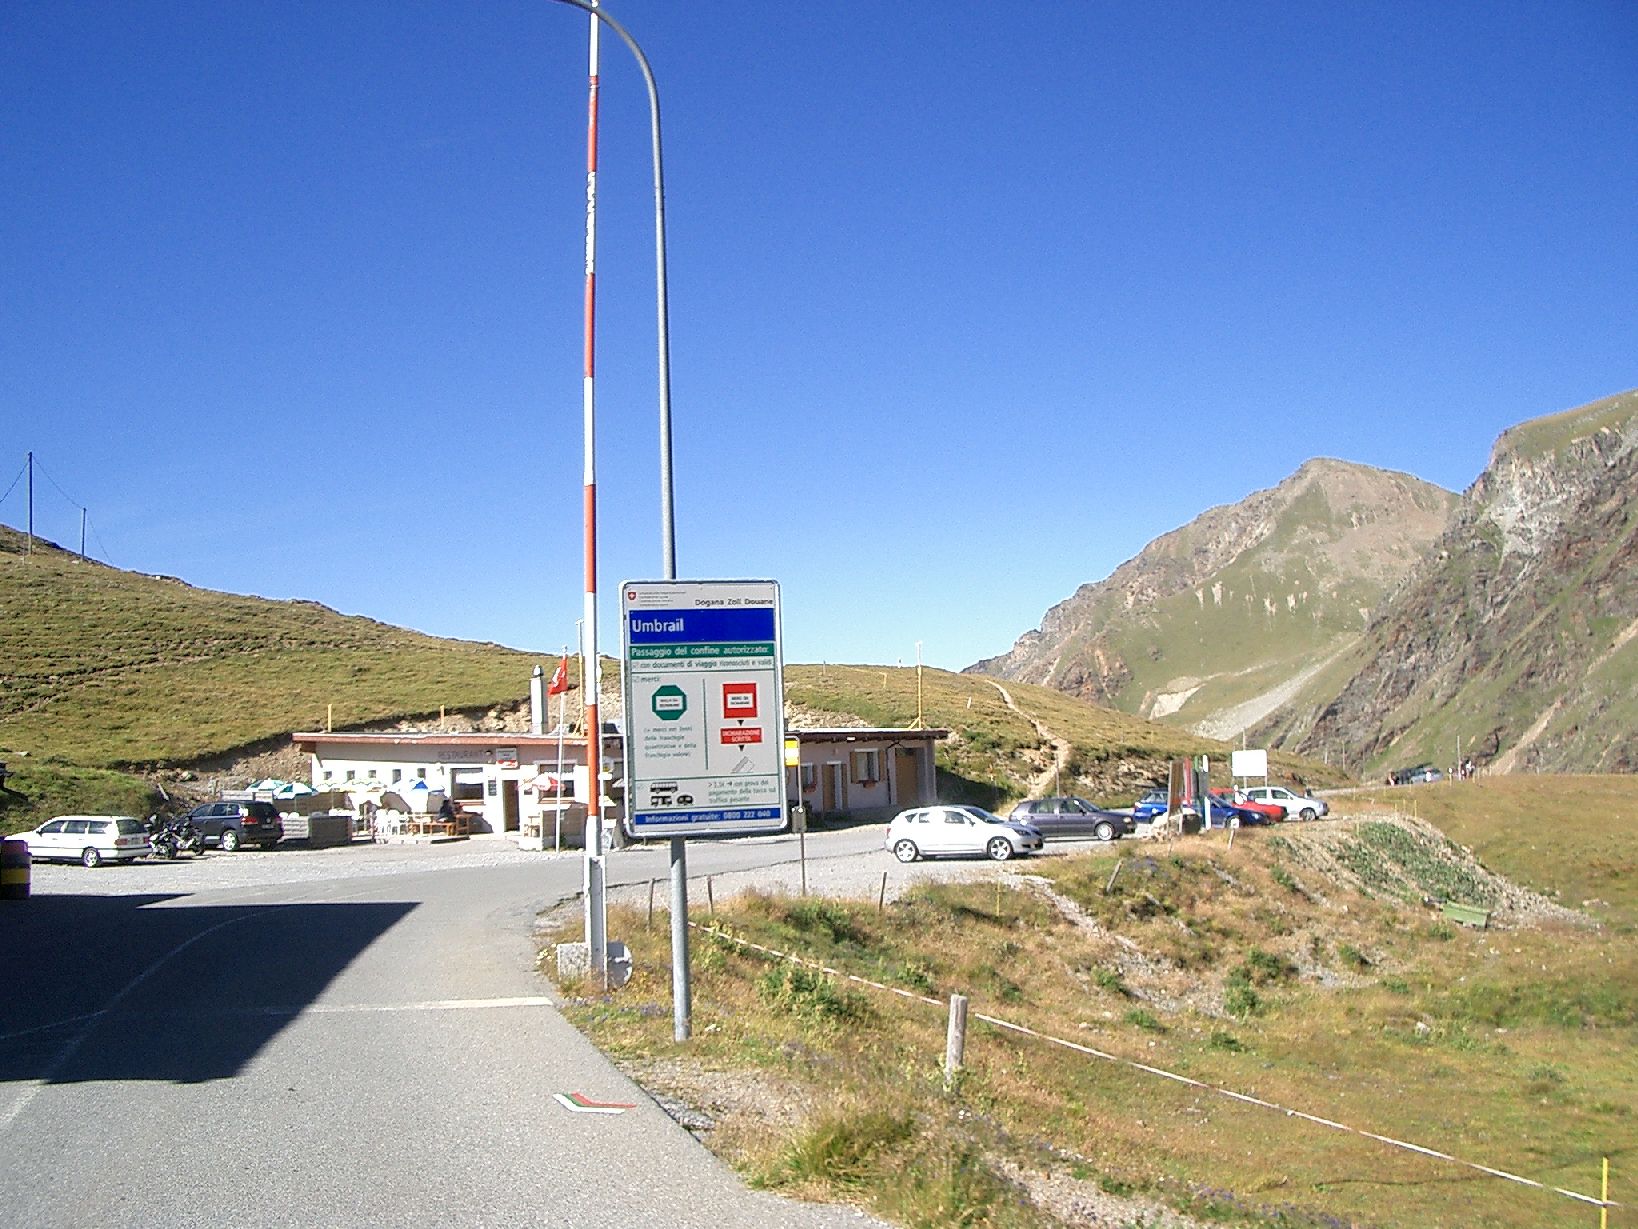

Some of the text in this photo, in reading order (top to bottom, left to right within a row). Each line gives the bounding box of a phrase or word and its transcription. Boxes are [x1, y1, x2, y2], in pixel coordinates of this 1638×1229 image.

[695, 599, 724, 607] Dogana
[631, 617, 685, 633] Umbrail
[631, 647, 672, 658] Passaggio
[674, 646, 688, 656] del
[690, 645, 720, 655] confine
[652, 661, 684, 669] documenti
[695, 660, 717, 669] viaggio
[645, 813, 689, 823] Informazioni
